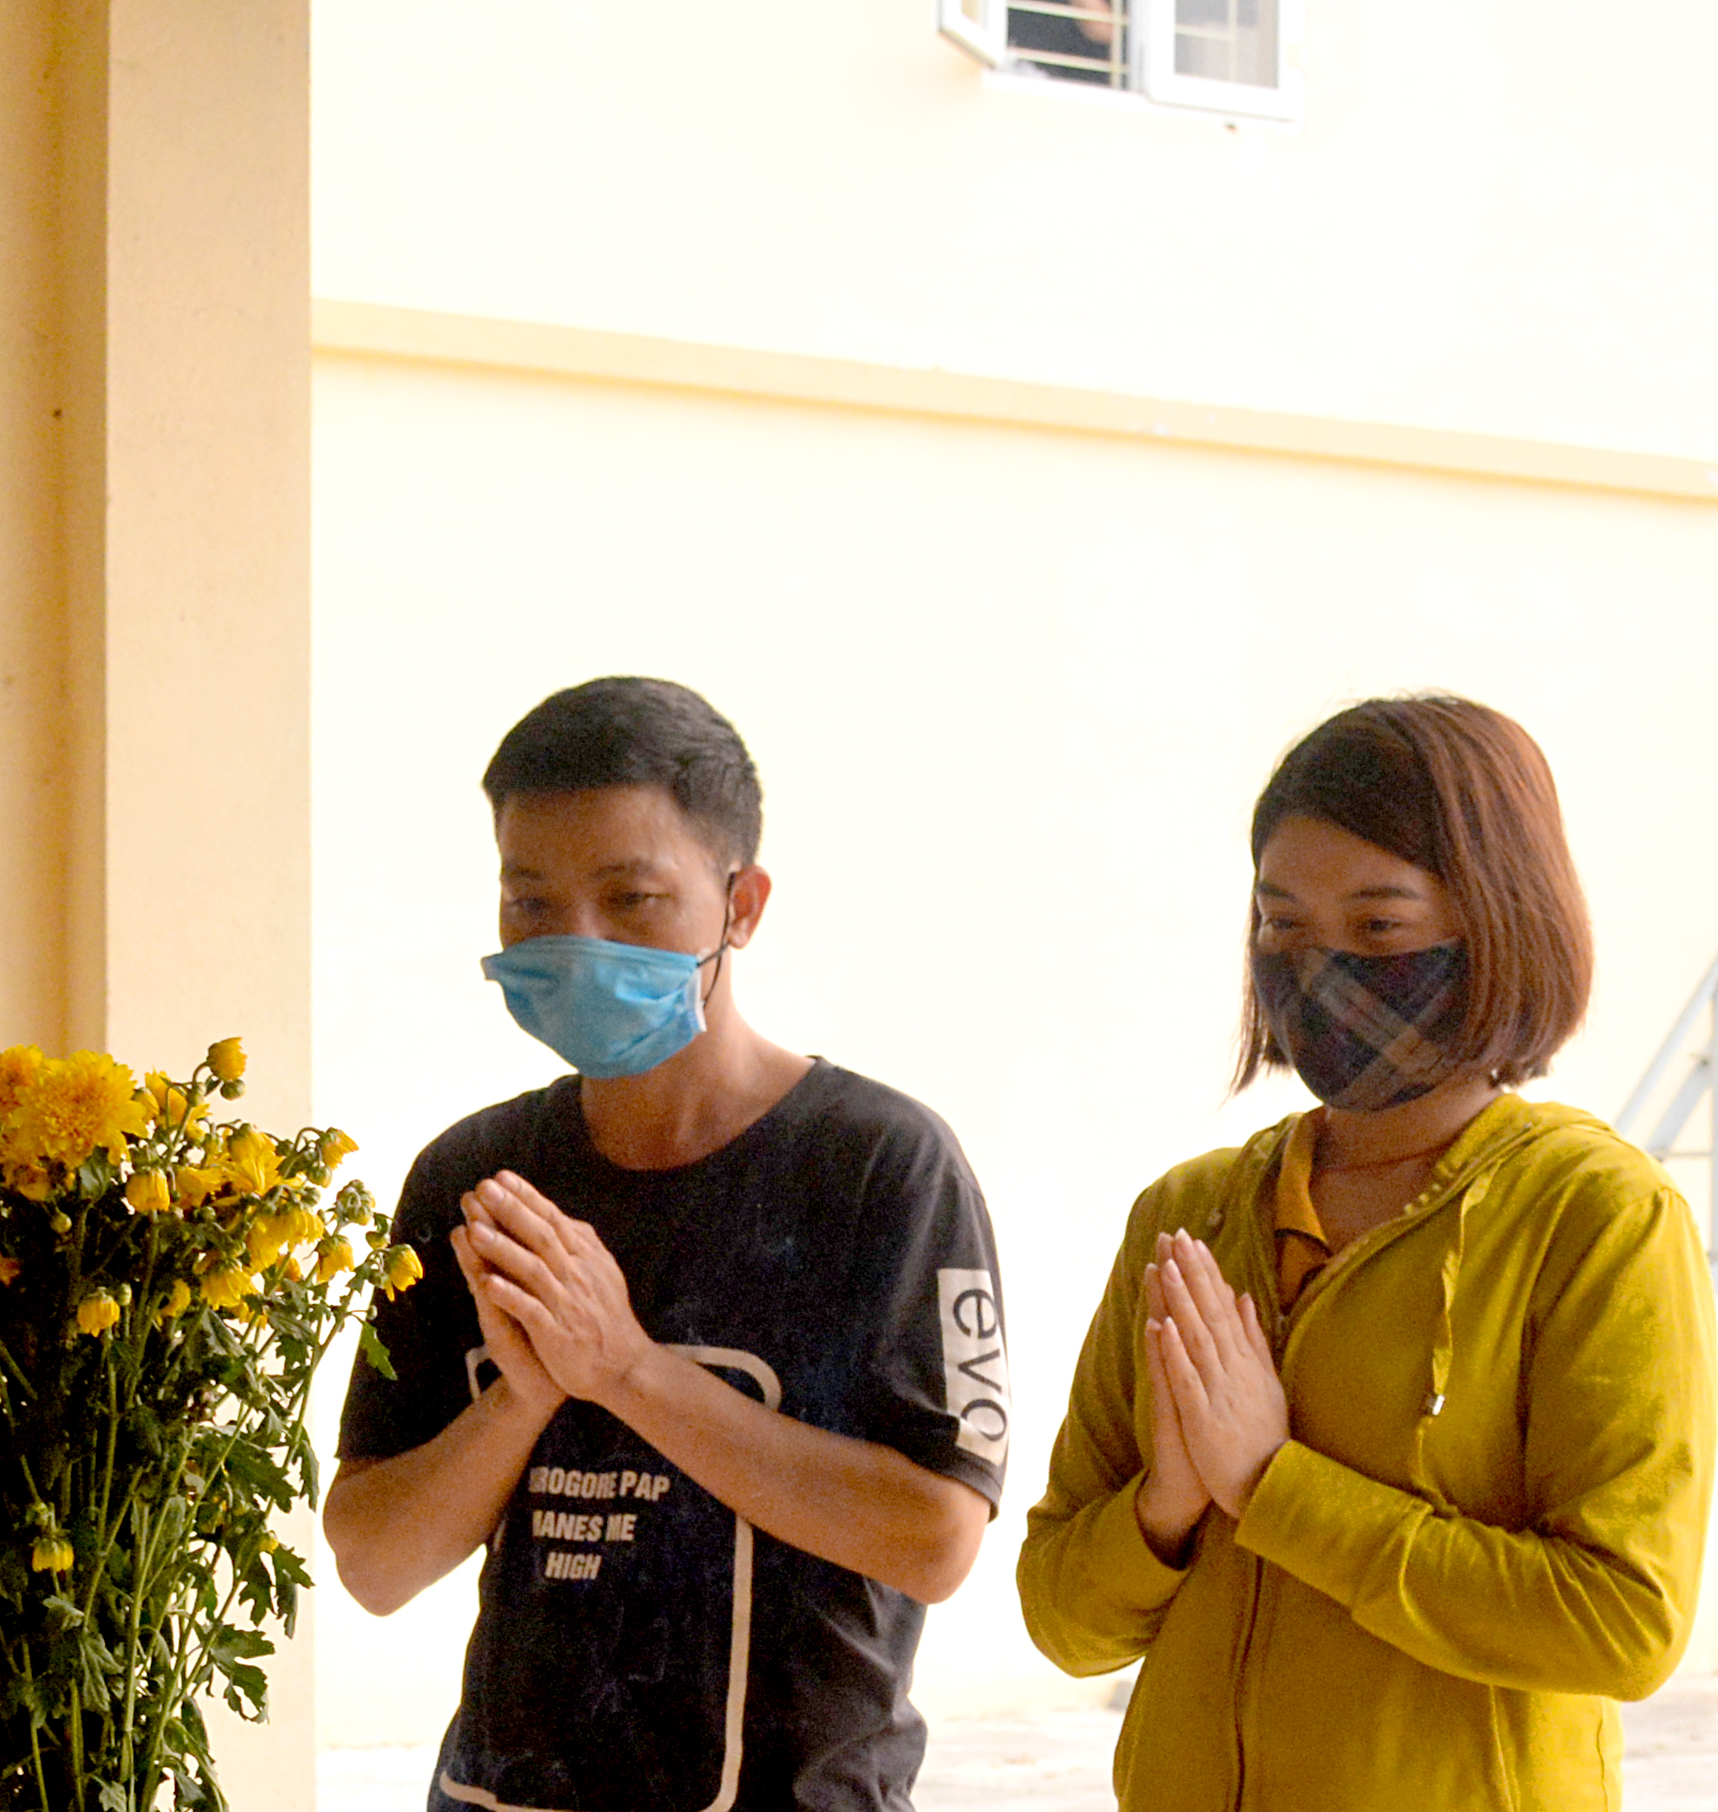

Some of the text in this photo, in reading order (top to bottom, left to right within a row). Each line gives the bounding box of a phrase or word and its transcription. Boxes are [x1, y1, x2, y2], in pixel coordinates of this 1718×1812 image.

[952, 1287, 1008, 1442] evo
[619, 1470, 671, 1501] PAP
[544, 1551, 602, 1580] HIGH
